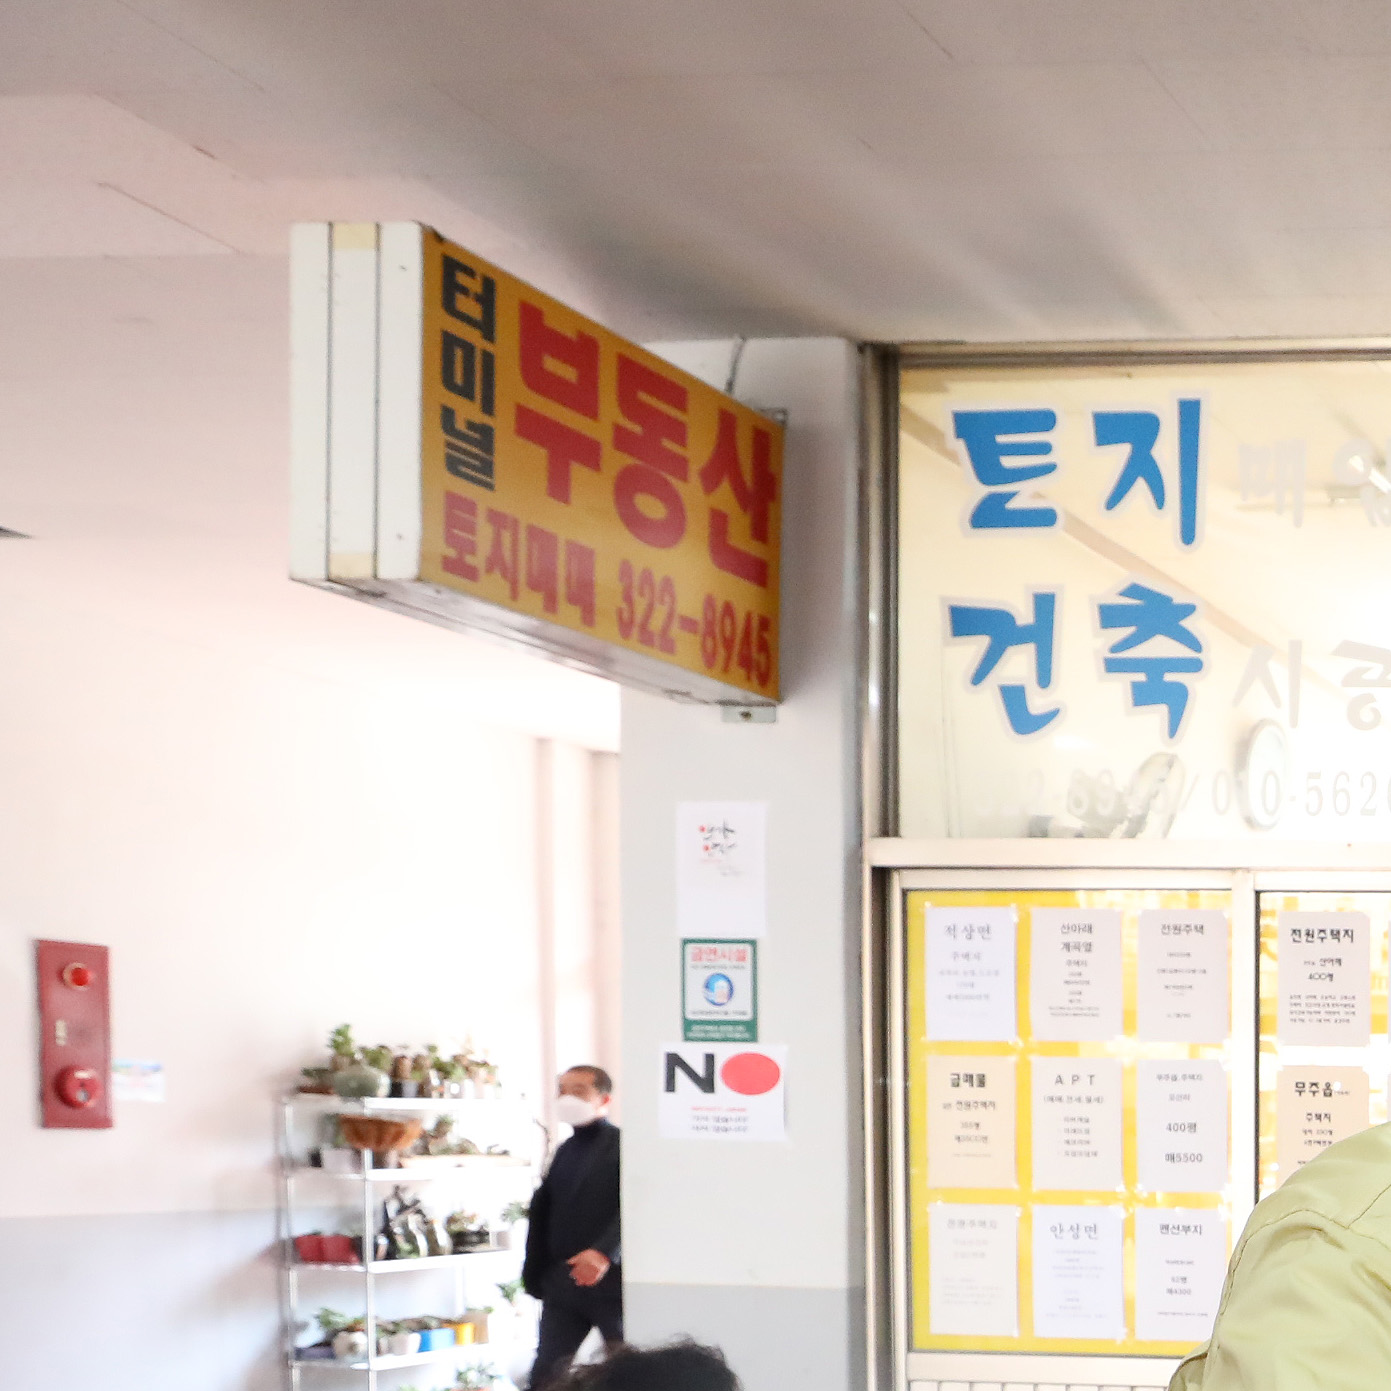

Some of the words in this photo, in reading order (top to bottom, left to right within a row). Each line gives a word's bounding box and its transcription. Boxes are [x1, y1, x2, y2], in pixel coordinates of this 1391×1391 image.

[441, 253, 495, 492] 터미널
[515, 299, 771, 589] 부동산
[951, 398, 1201, 545] 토지
[442, 490, 596, 628] 토지매매
[617, 559, 771, 689] 322-8945
[949, 582, 1203, 739] 건축
[1161, 924, 1204, 936] 전원주택
[1290, 928, 1354, 943] 전원주택지
[950, 1073, 987, 1088] 급매물
[1295, 1081, 1333, 1097] 무주읍
